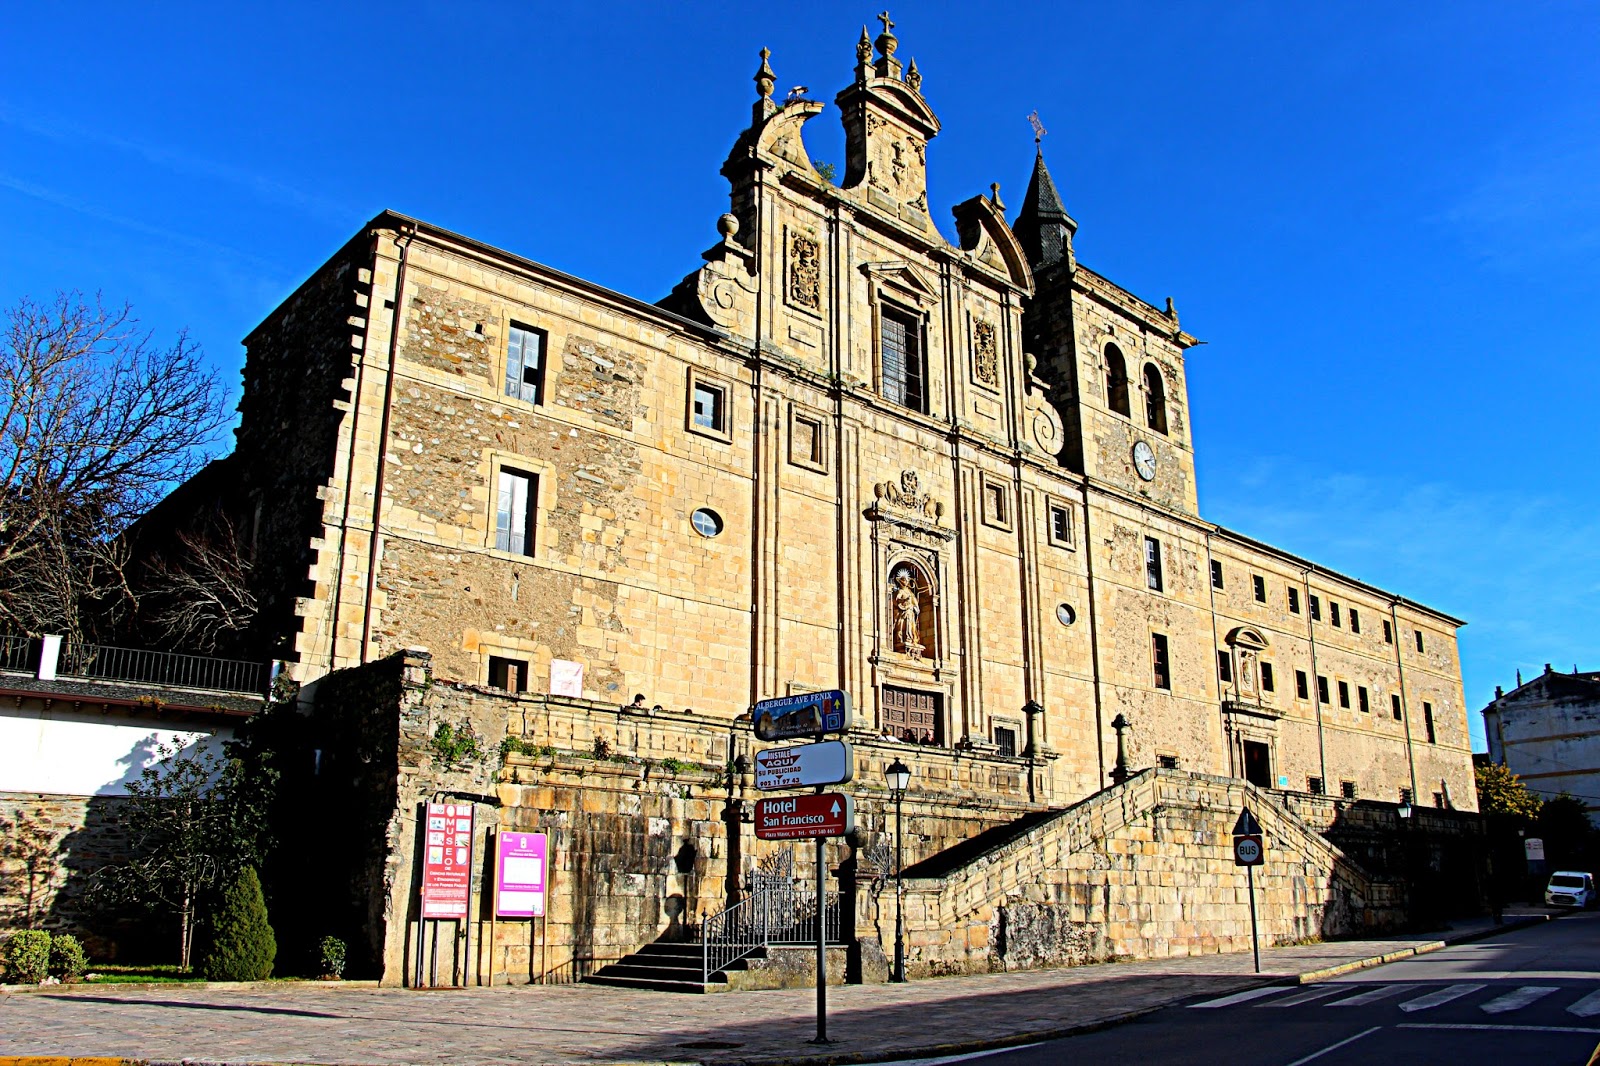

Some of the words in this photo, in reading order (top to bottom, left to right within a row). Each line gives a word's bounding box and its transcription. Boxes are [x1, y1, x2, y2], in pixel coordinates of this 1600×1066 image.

[756, 697, 793, 710] ALBERGUE
[795, 695, 808, 704] AVE
[811, 692, 832, 702] FENIX
[768, 750, 790, 759] INSTALE
[766, 758, 793, 767] AQUI
[768, 766, 801, 775] PUBLICIDAD
[763, 798, 796, 814] Hotel
[763, 816, 779, 826] San
[782, 814, 824, 825] Francisco
[444, 818, 455, 867] MUSEO
[1240, 846, 1256, 855] BUS
